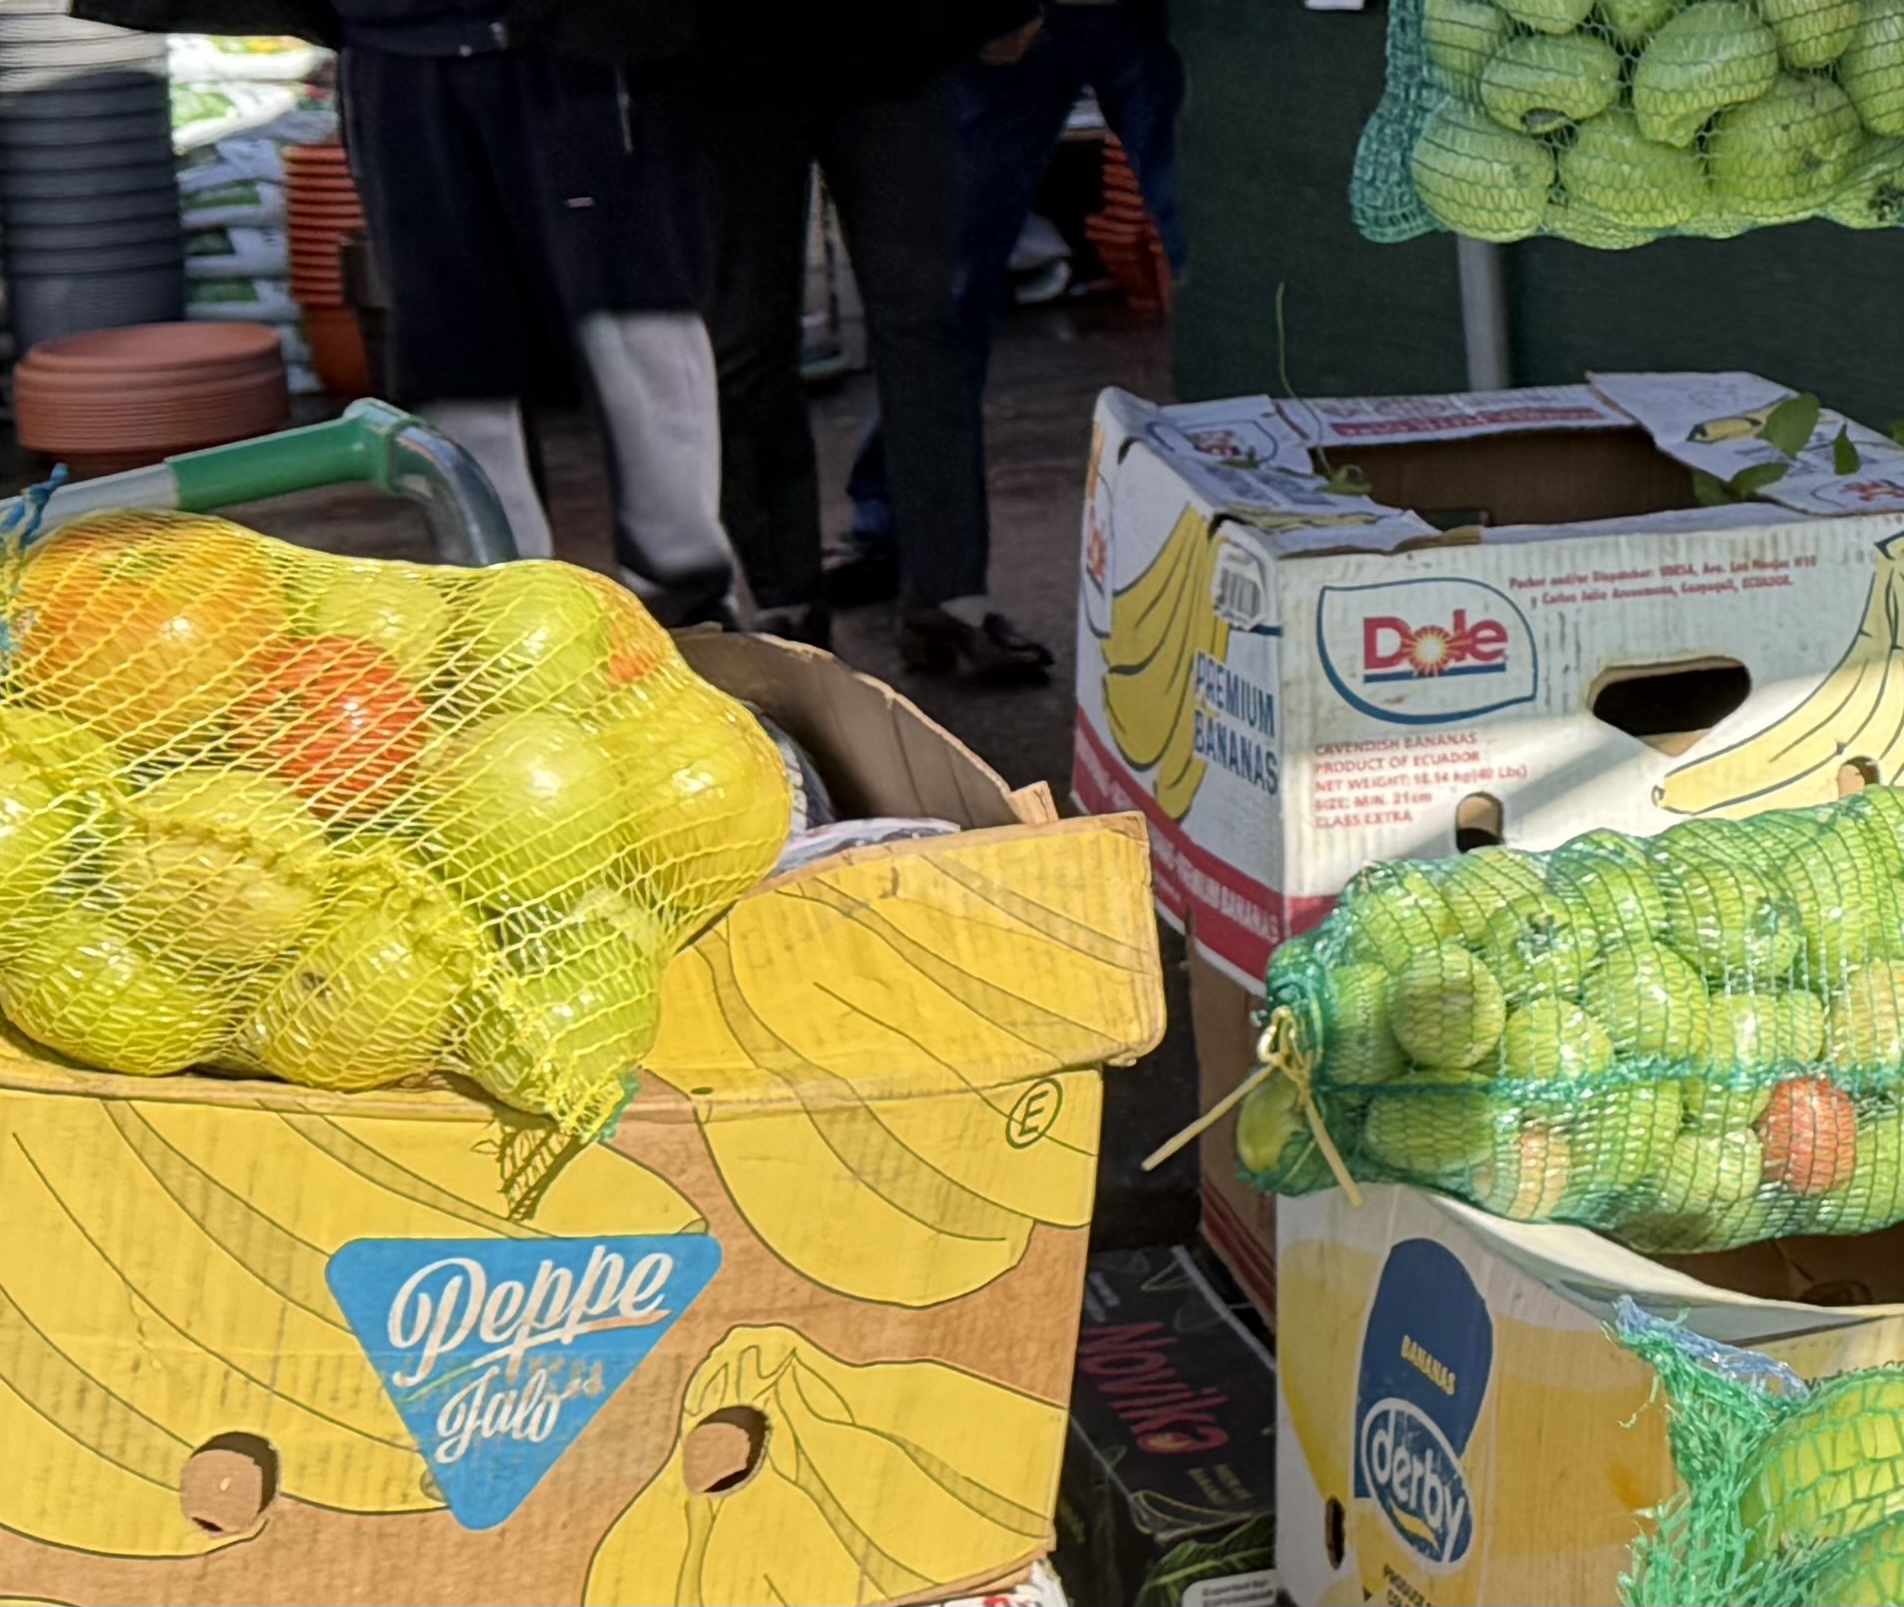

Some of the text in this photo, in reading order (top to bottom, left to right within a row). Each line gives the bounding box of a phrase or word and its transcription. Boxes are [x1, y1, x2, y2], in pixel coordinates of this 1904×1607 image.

[1363, 608, 1509, 677] Dole
[1194, 649, 1277, 740] PREMIUM
[1194, 708, 1279, 795] BANANAS
[1314, 751, 1480, 774] PRODUCT OF ECUADOR
[1404, 731, 1478, 749] BANANAS
[1314, 778, 1343, 793] NET
[1314, 809, 1413, 829] CLASS EXTRA
[387, 1244, 674, 1387] Peppe
[1400, 1334, 1457, 1396] BANANAS
[1371, 1408, 1466, 1564] derby
